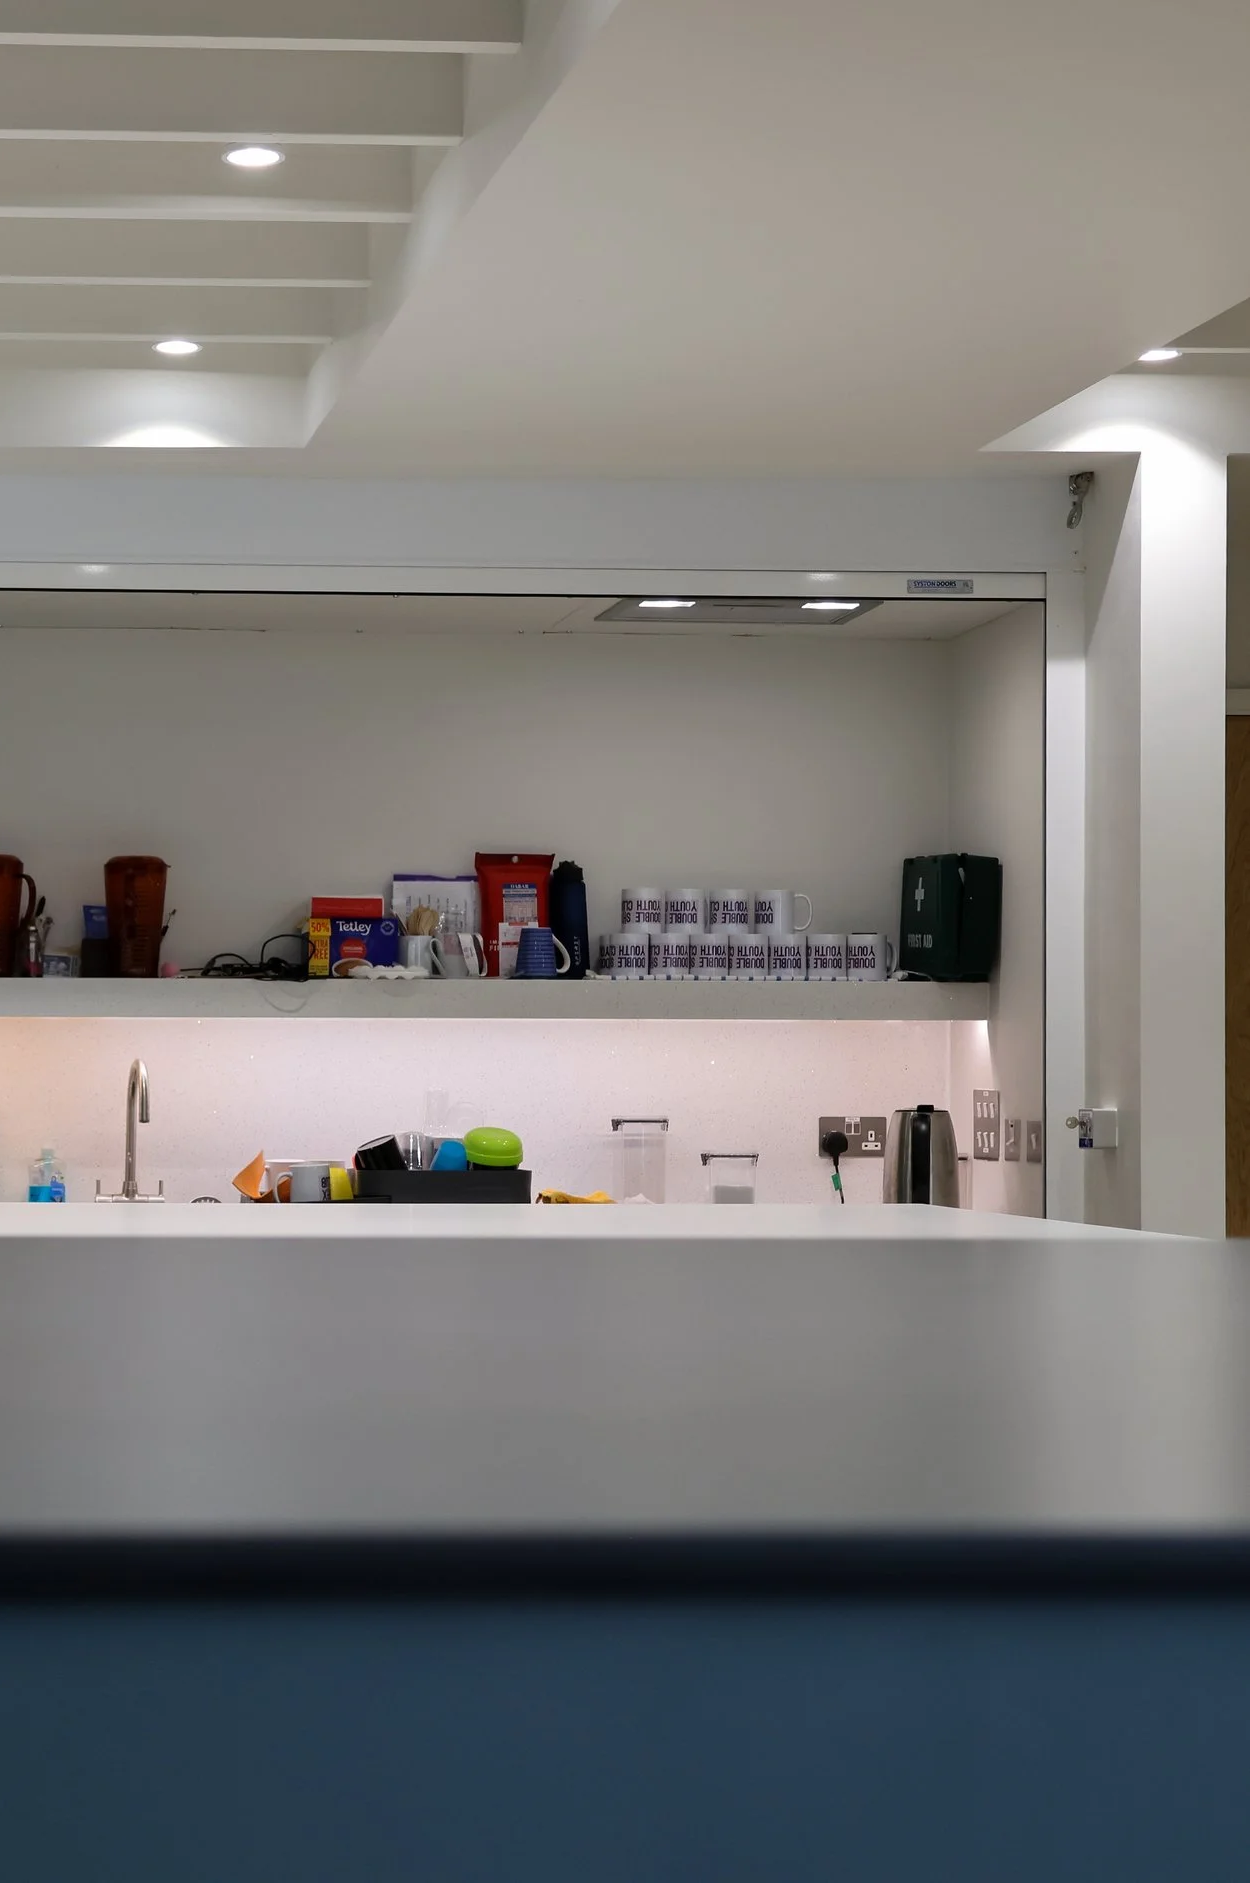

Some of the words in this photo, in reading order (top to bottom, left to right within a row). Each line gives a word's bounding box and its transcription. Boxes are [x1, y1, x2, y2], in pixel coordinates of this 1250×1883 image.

[637, 900, 661, 911] YOUTH
[669, 901, 697, 912] YOUTH
[722, 901, 748, 912] YOUTH
[669, 912, 698, 924] DOUBLE
[311, 921, 330, 933] 50%
[336, 920, 372, 936] Tetley
[923, 933, 933, 948] AID
[618, 945, 645, 956] YOUTH
[663, 945, 688, 956] YOUTH
[700, 945, 727, 956] YOUTH
[737, 946, 765, 957] YOUTH
[773, 946, 802, 957] YOUTH
[814, 946, 843, 957] YOUTH
[848, 945, 876, 957] YOUTH
[617, 956, 646, 968] DOUBLE
[662, 956, 688, 968] DOUBLE
[699, 957, 727, 968] DOUBLE
[736, 957, 765, 969] DOUBLE
[773, 957, 802, 969] DOUBLE
[813, 957, 843, 969] DOUBLE
[847, 957, 876, 969] DOUBLE
